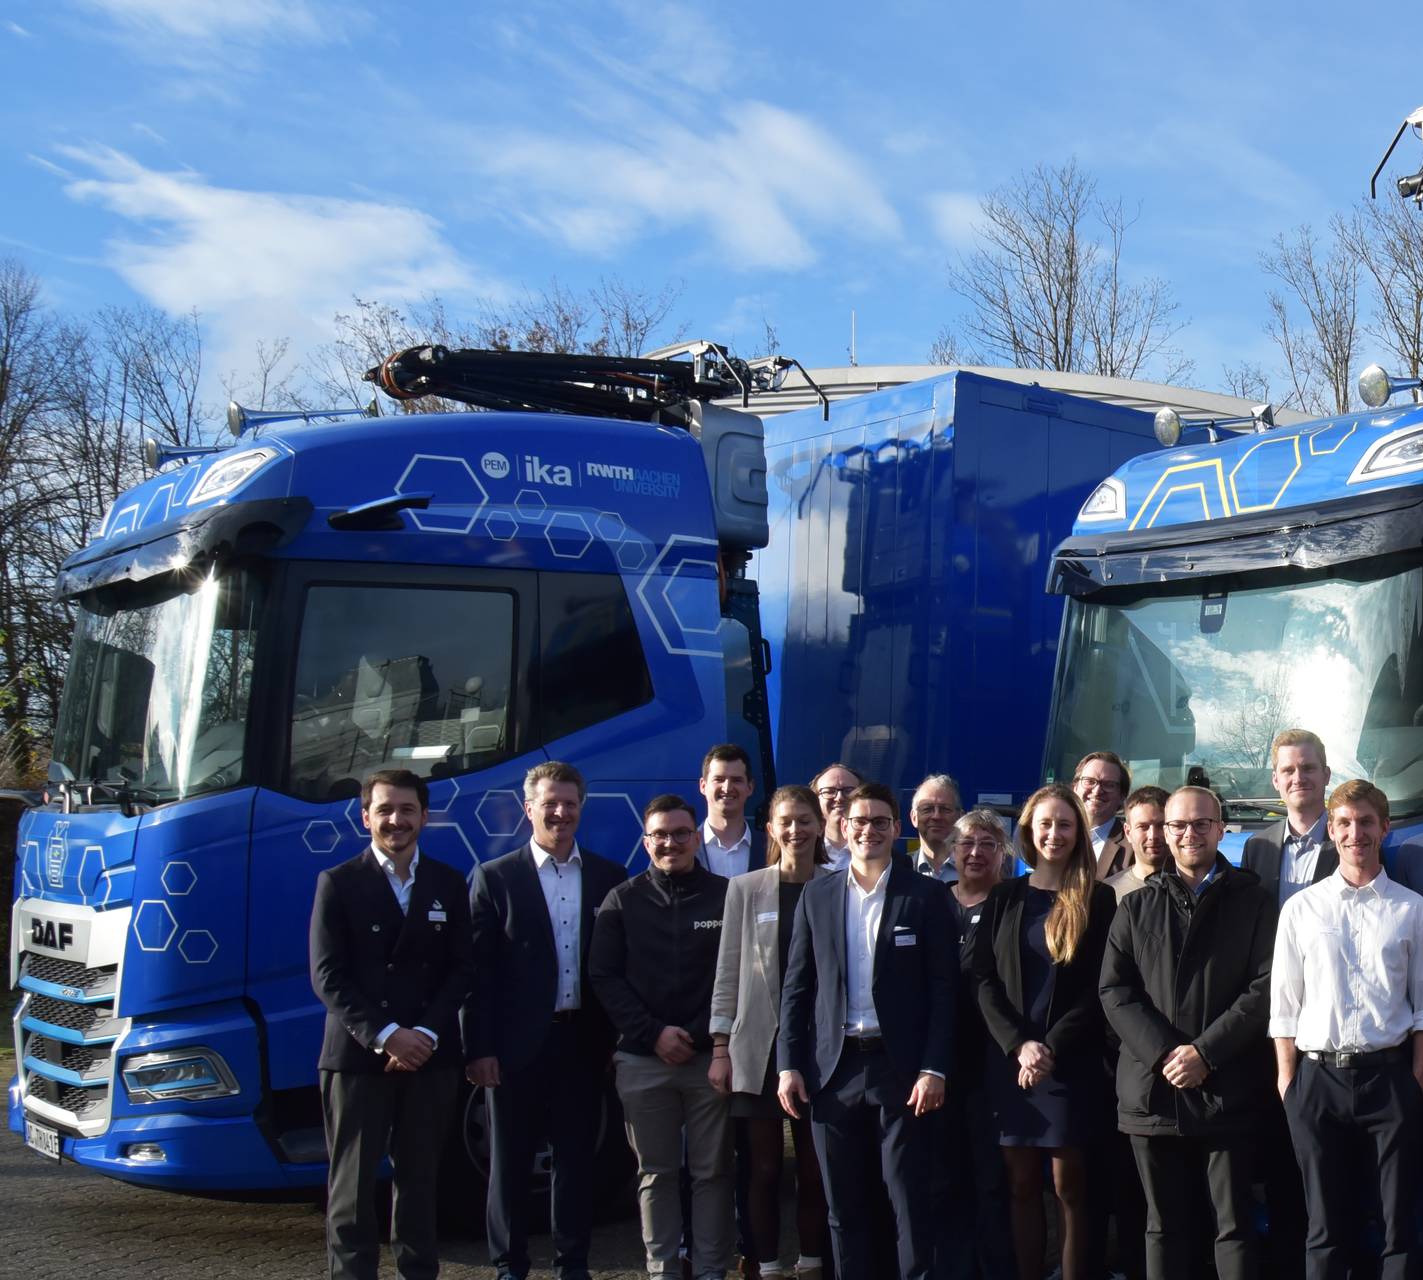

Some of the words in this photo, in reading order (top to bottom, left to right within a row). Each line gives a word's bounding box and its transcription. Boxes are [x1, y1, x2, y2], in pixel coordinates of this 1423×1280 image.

[484, 458, 507, 472] PEM
[525, 455, 573, 487] ika
[613, 479, 681, 499] UNIVERSITY
[31, 917, 73, 952] DAF
